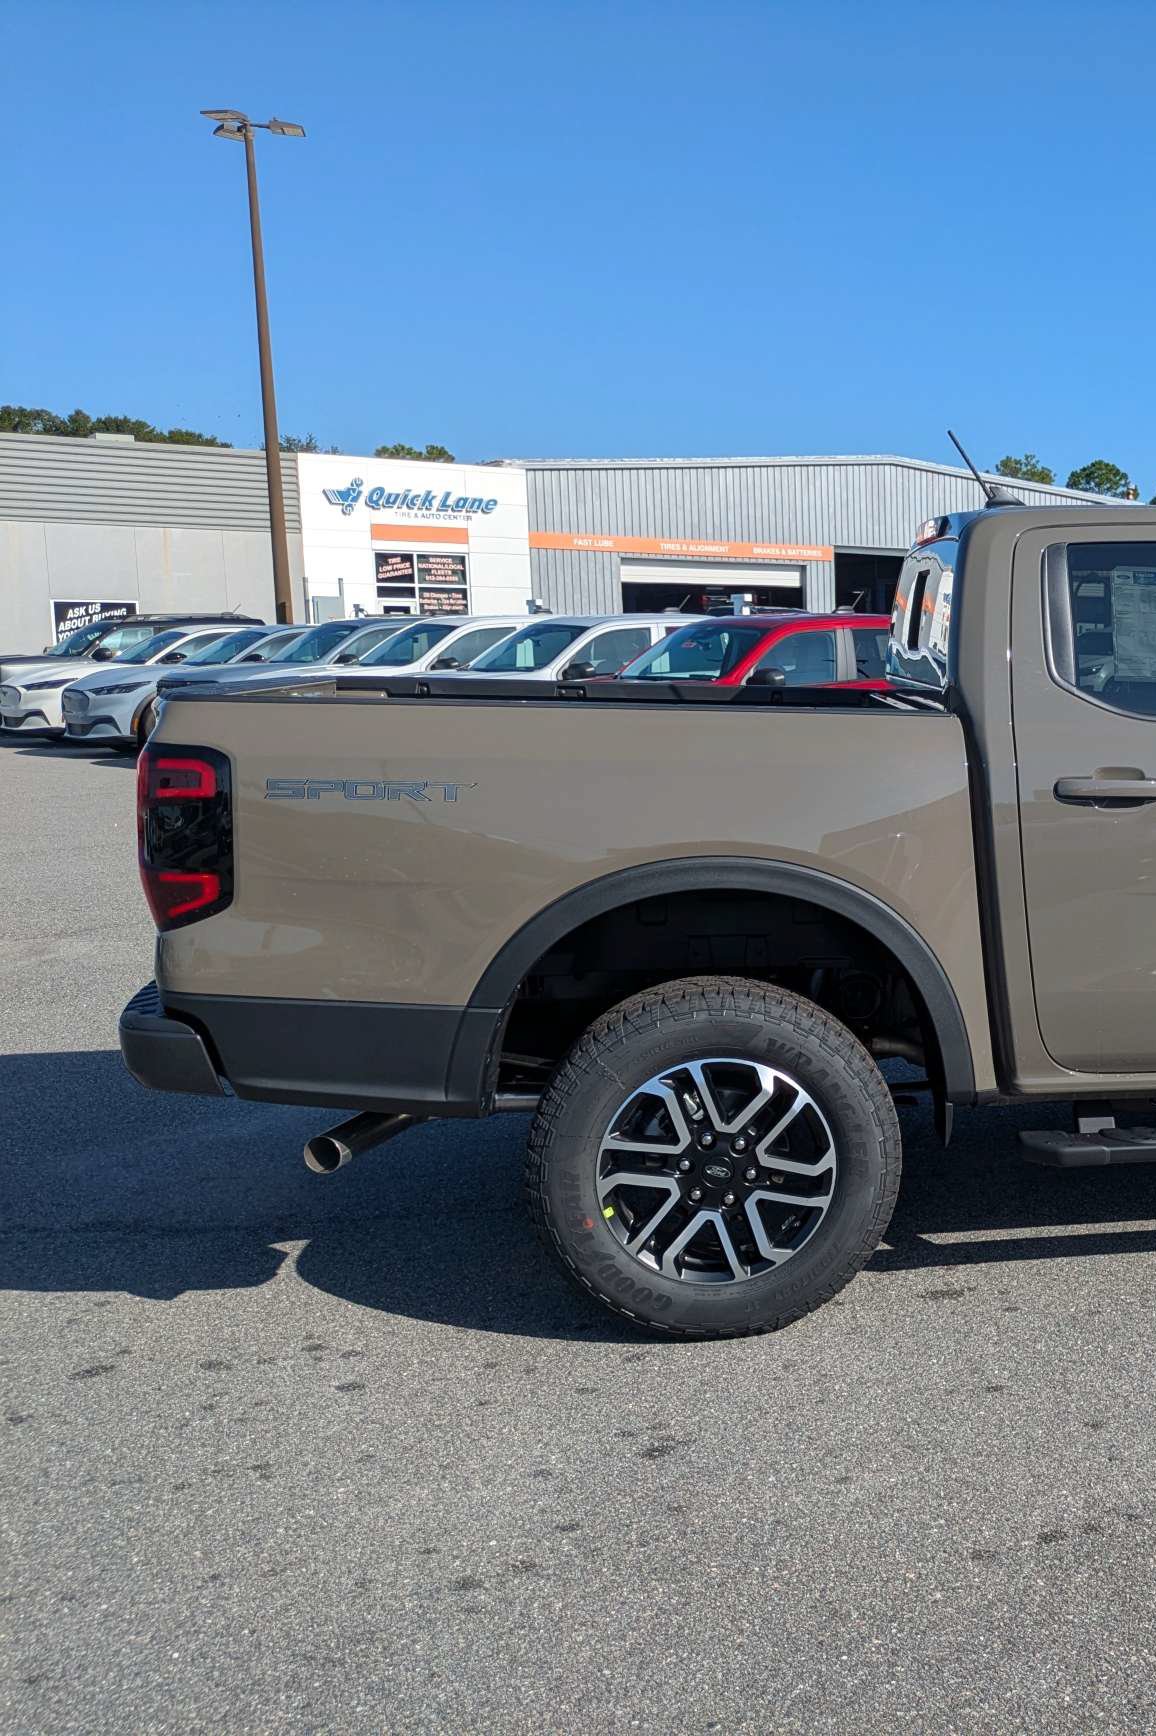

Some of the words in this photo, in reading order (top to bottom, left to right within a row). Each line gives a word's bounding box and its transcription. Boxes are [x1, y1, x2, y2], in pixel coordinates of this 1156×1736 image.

[365, 486, 437, 509] Quick
[436, 491, 498, 514] Lane
[420, 512, 441, 520] AUTO
[442, 513, 473, 521] CENTER
[574, 538, 592, 546] FAST
[593, 539, 614, 547] LUBE
[660, 543, 682, 551] TIRES
[688, 544, 729, 552] ALIGNMENT
[752, 546, 780, 554] BRAKES
[787, 548, 822, 557] BATTERIES
[379, 564, 393, 573] LOW
[393, 562, 411, 571] PRICE
[67, 606, 87, 619] ASK
[88, 603, 101, 615] US
[58, 616, 91, 632] ABOUT
[264, 778, 478, 802] SPORT
